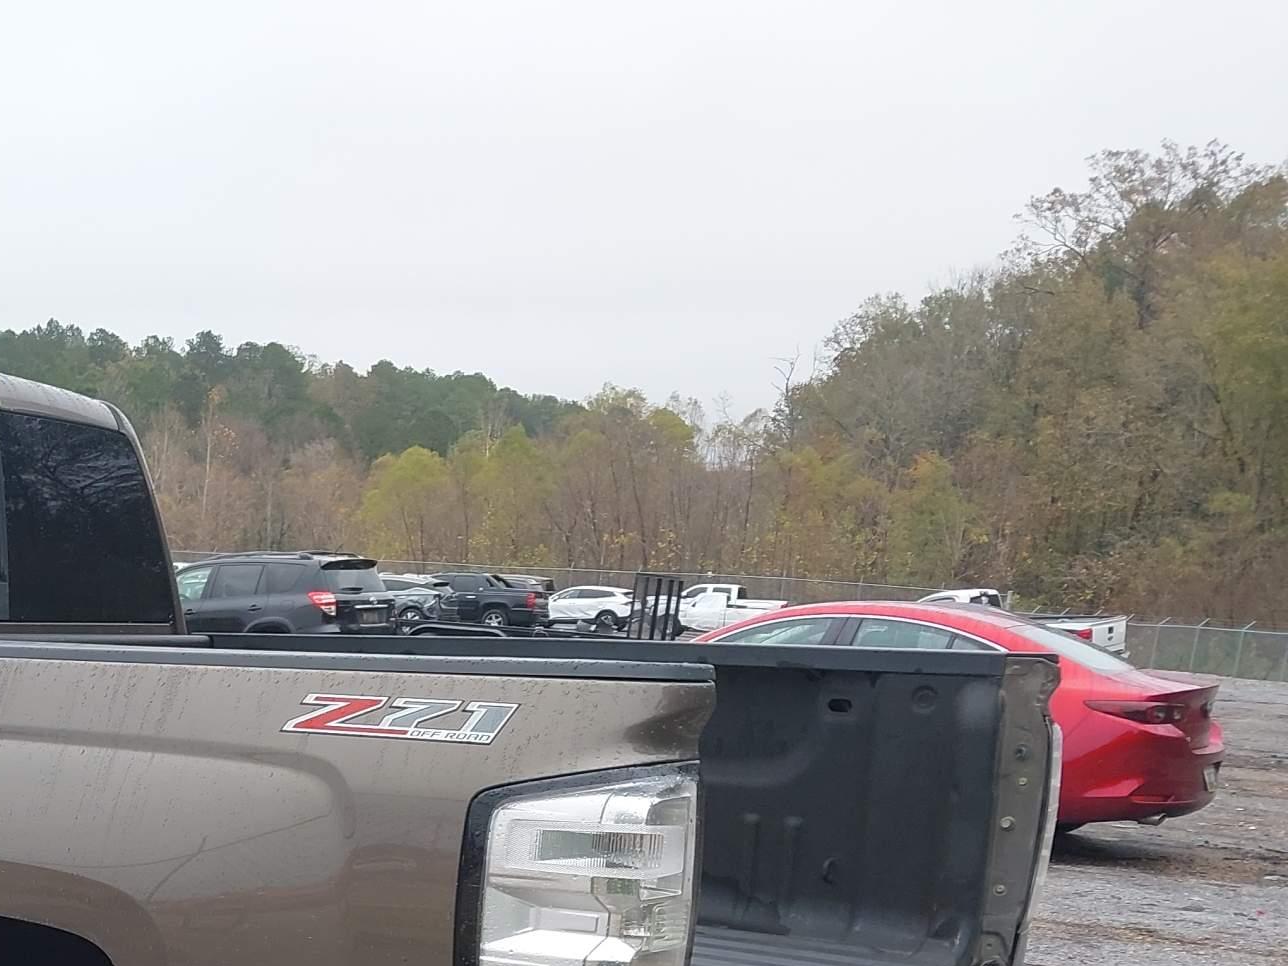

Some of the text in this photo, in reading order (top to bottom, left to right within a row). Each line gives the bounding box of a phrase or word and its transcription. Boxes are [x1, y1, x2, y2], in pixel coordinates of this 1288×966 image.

[280, 693, 520, 745] Z71
[409, 730, 491, 742] OFF ROAD
